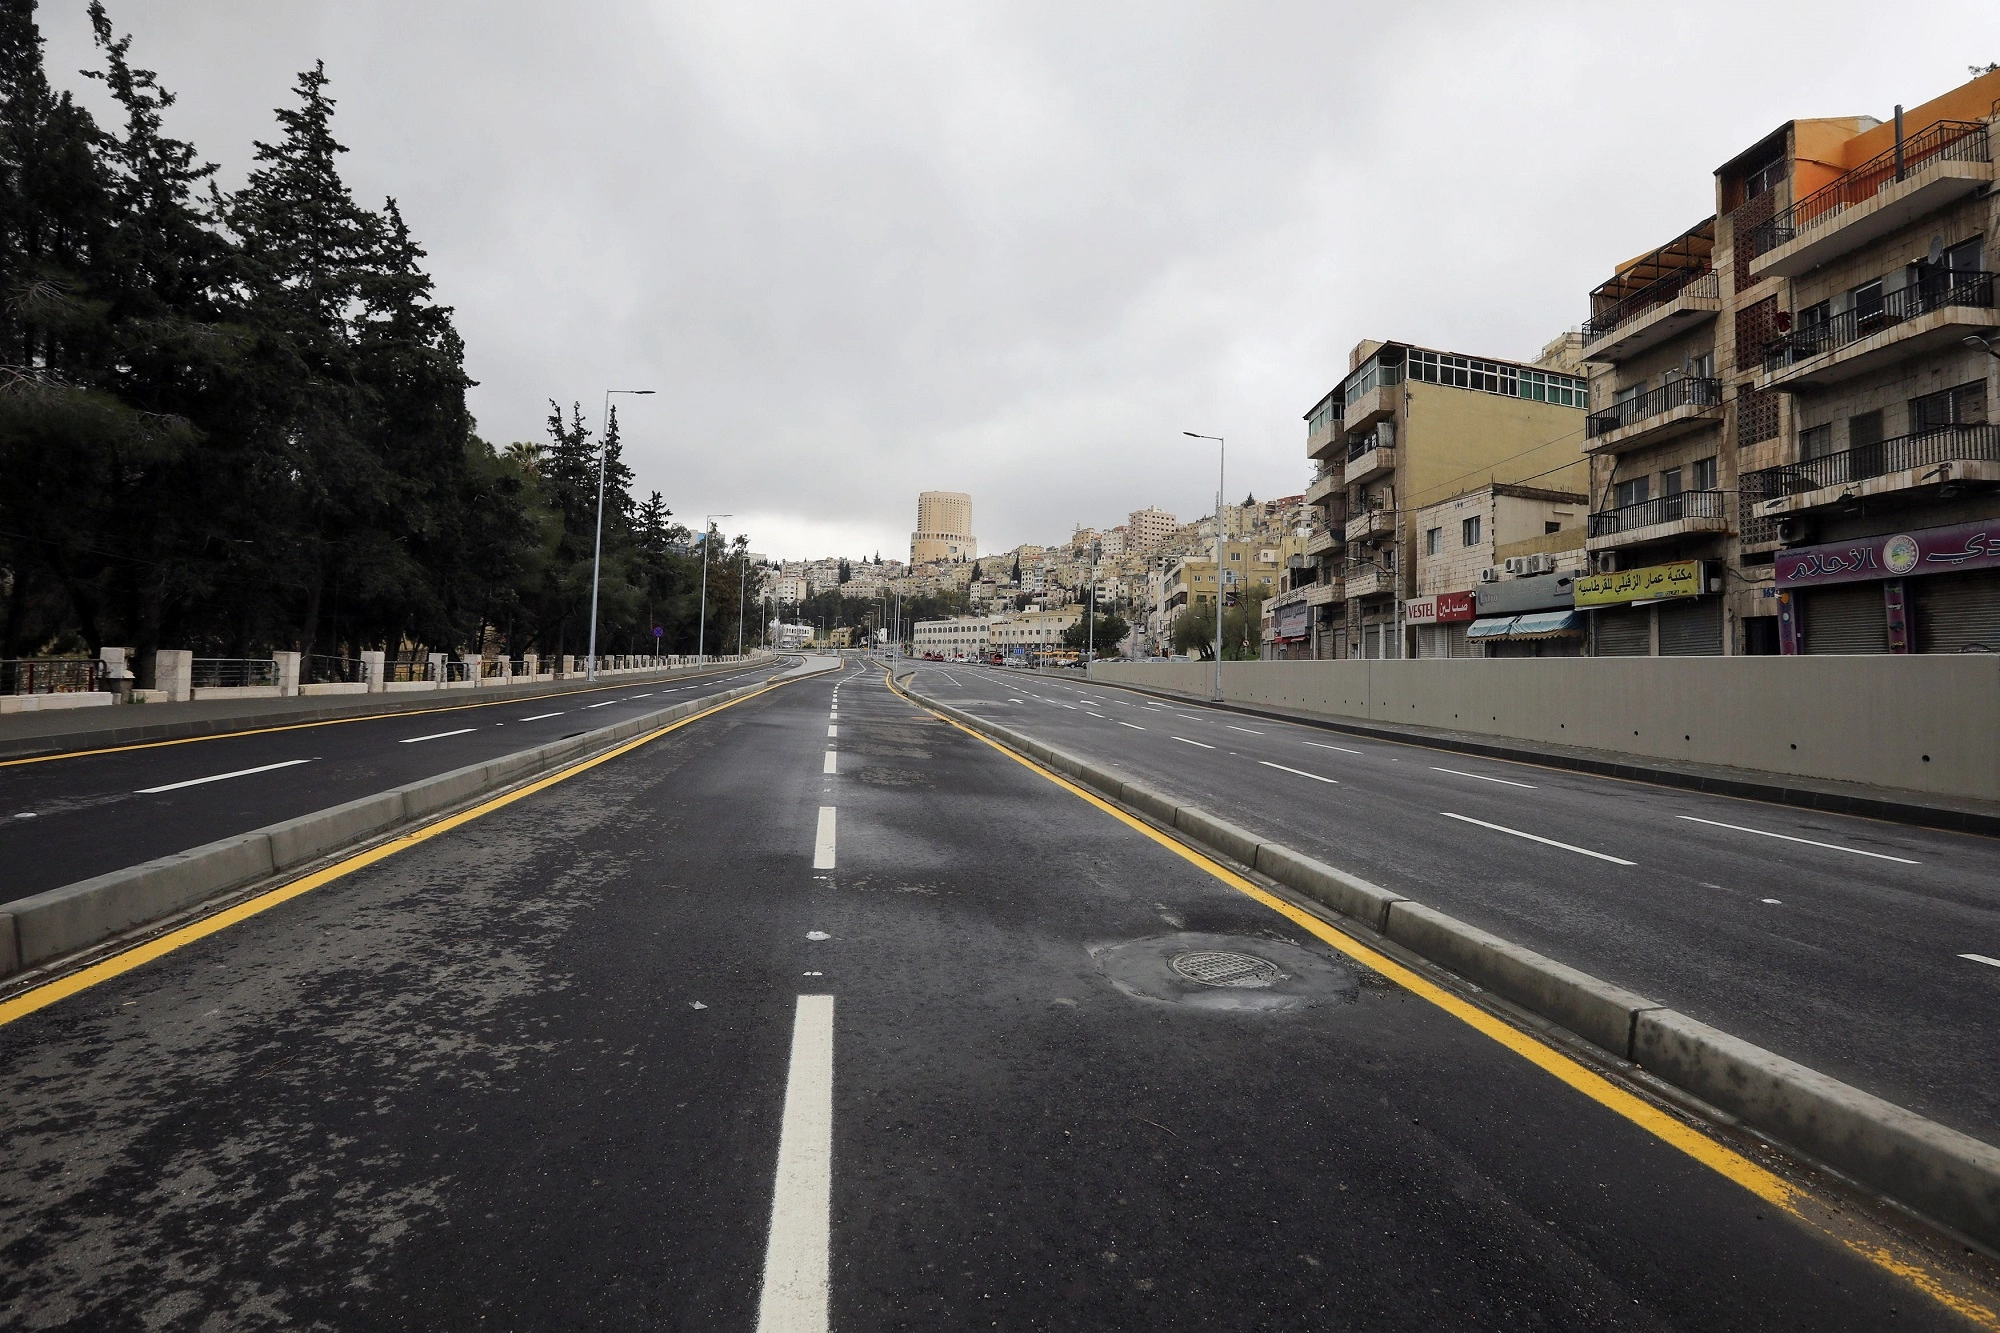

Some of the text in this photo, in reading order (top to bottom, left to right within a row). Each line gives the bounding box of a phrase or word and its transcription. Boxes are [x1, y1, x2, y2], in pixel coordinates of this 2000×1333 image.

[1787, 547, 1878, 581] الأحلام
[1891, 561, 1913, 572] VALLEY
[1645, 573, 1664, 589] عمار
[1668, 567, 1692, 585] مكتبة
[1408, 602, 1435, 619] VESTEL
[1452, 603, 1468, 617] صب
